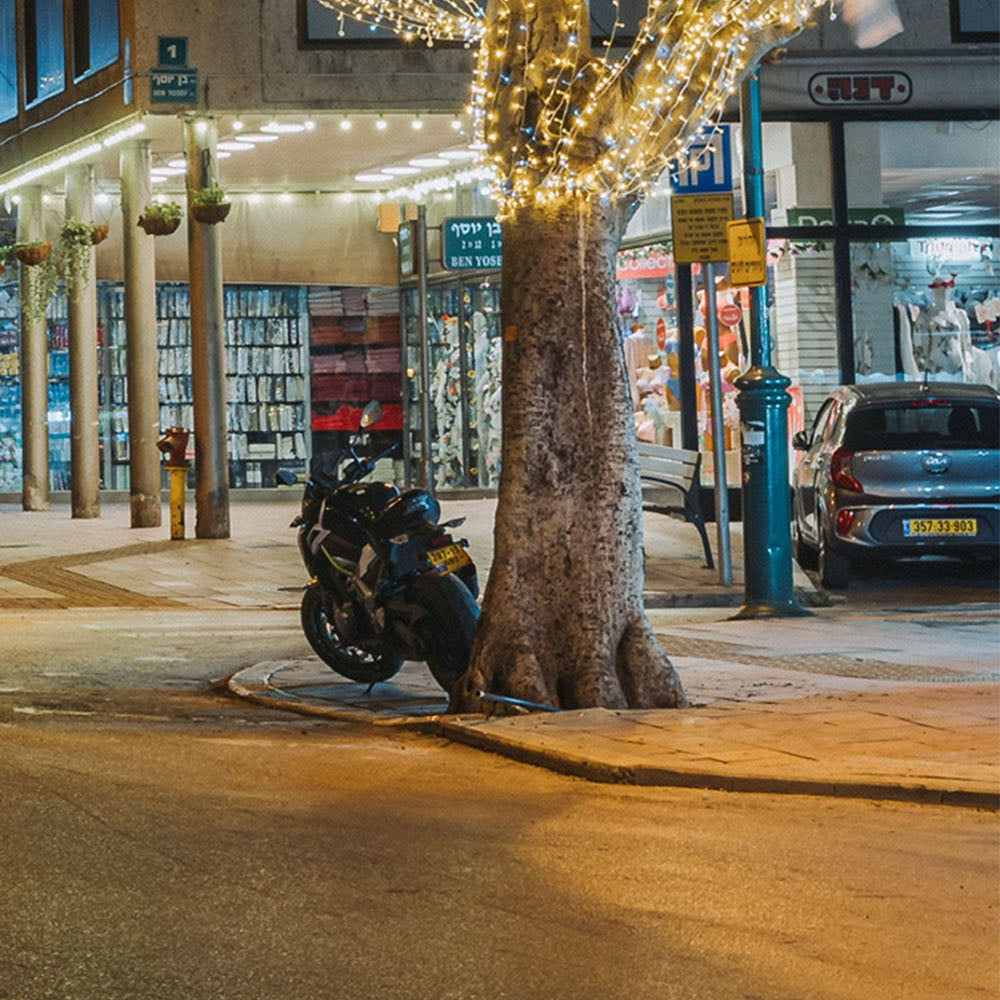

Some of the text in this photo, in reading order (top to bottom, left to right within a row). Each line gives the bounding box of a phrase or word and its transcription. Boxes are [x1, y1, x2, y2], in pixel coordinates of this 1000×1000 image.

[167, 45, 177, 58] 1
[152, 74, 188, 86] בן יוסף
[827, 76, 895, 101] דנה
[451, 222, 502, 237] בן יוסף
[451, 255, 503, 267] BEN YOSE
